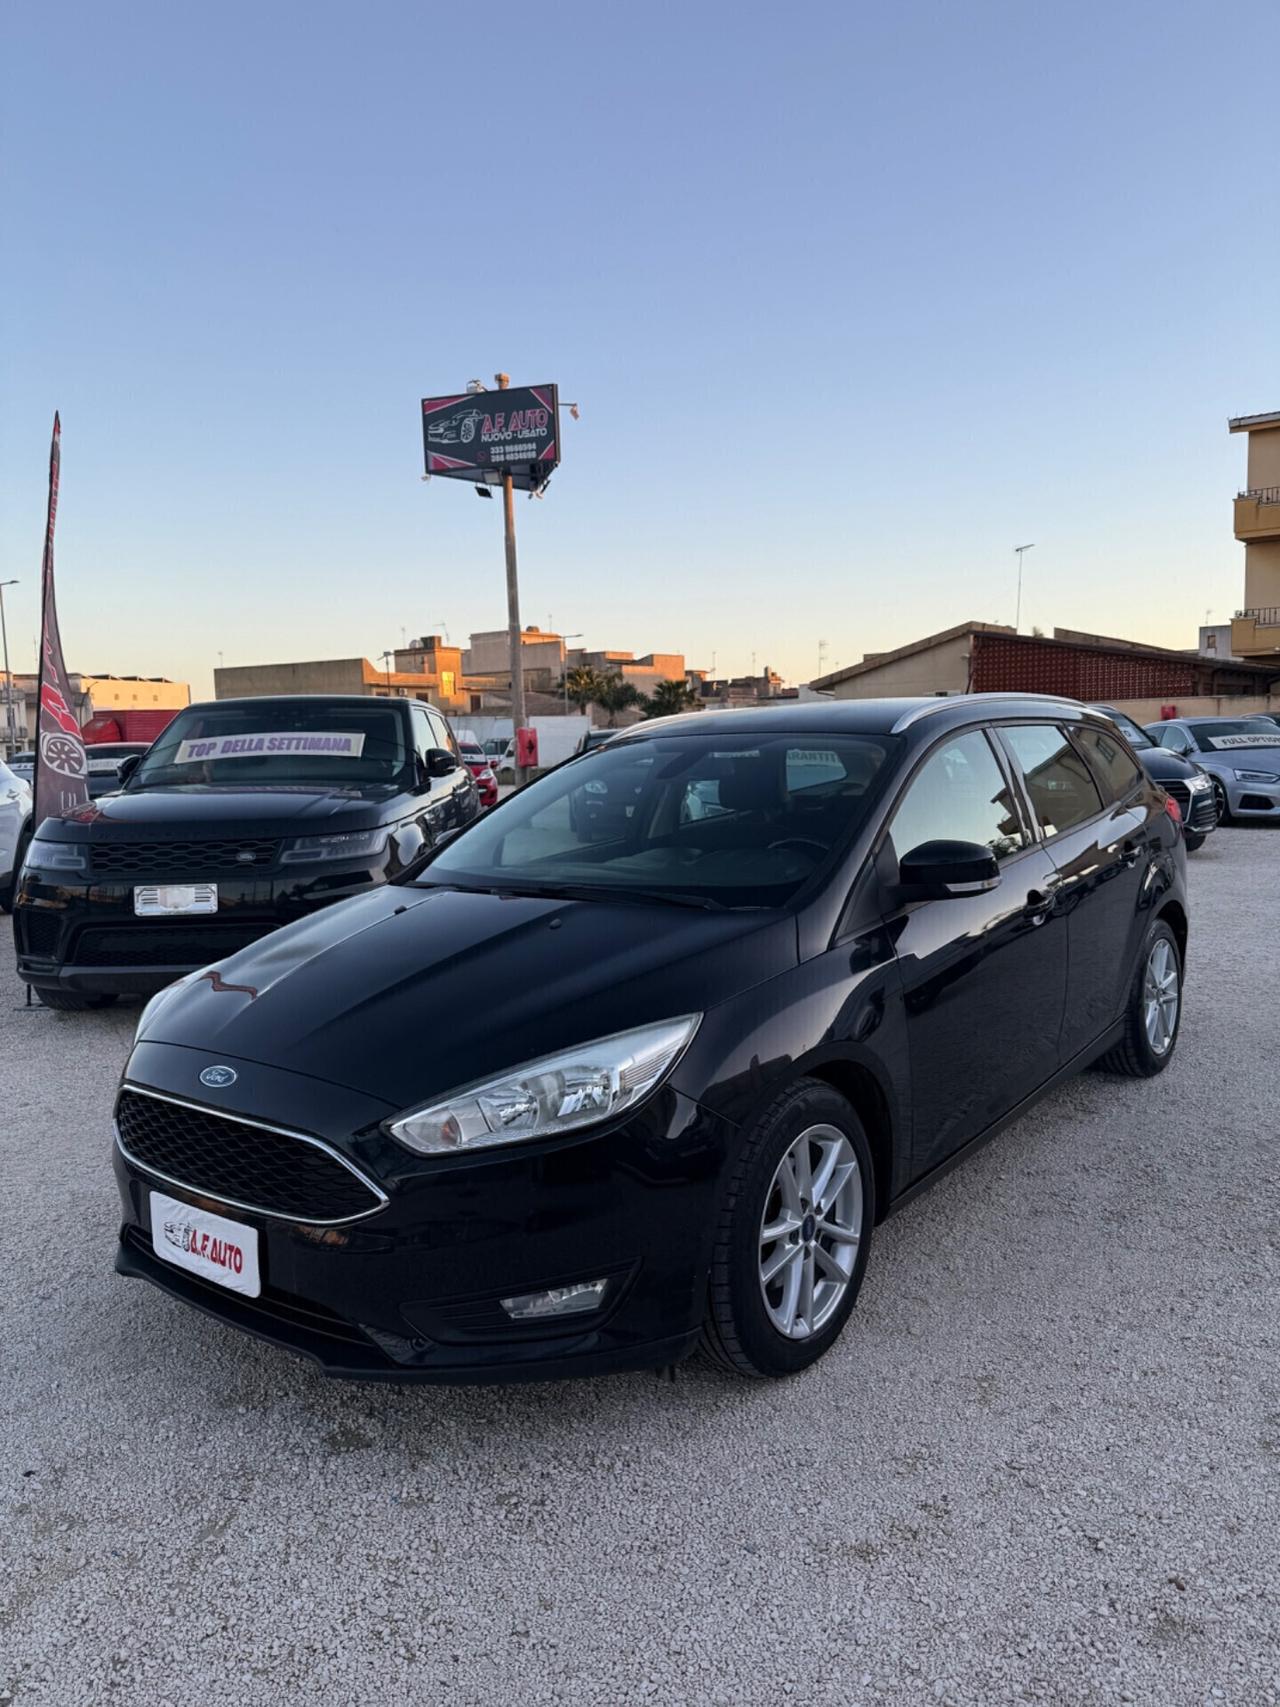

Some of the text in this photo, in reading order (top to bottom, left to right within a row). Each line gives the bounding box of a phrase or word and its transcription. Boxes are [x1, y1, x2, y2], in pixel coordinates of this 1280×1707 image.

[509, 408, 548, 431] AUTO
[481, 431, 512, 442] NUOVO
[517, 428, 548, 439] USATO
[187, 742, 217, 758] TOP
[267, 737, 352, 752] SETTIMANA
[1222, 737, 1246, 745] FULL
[210, 1237, 243, 1275] AUTO
